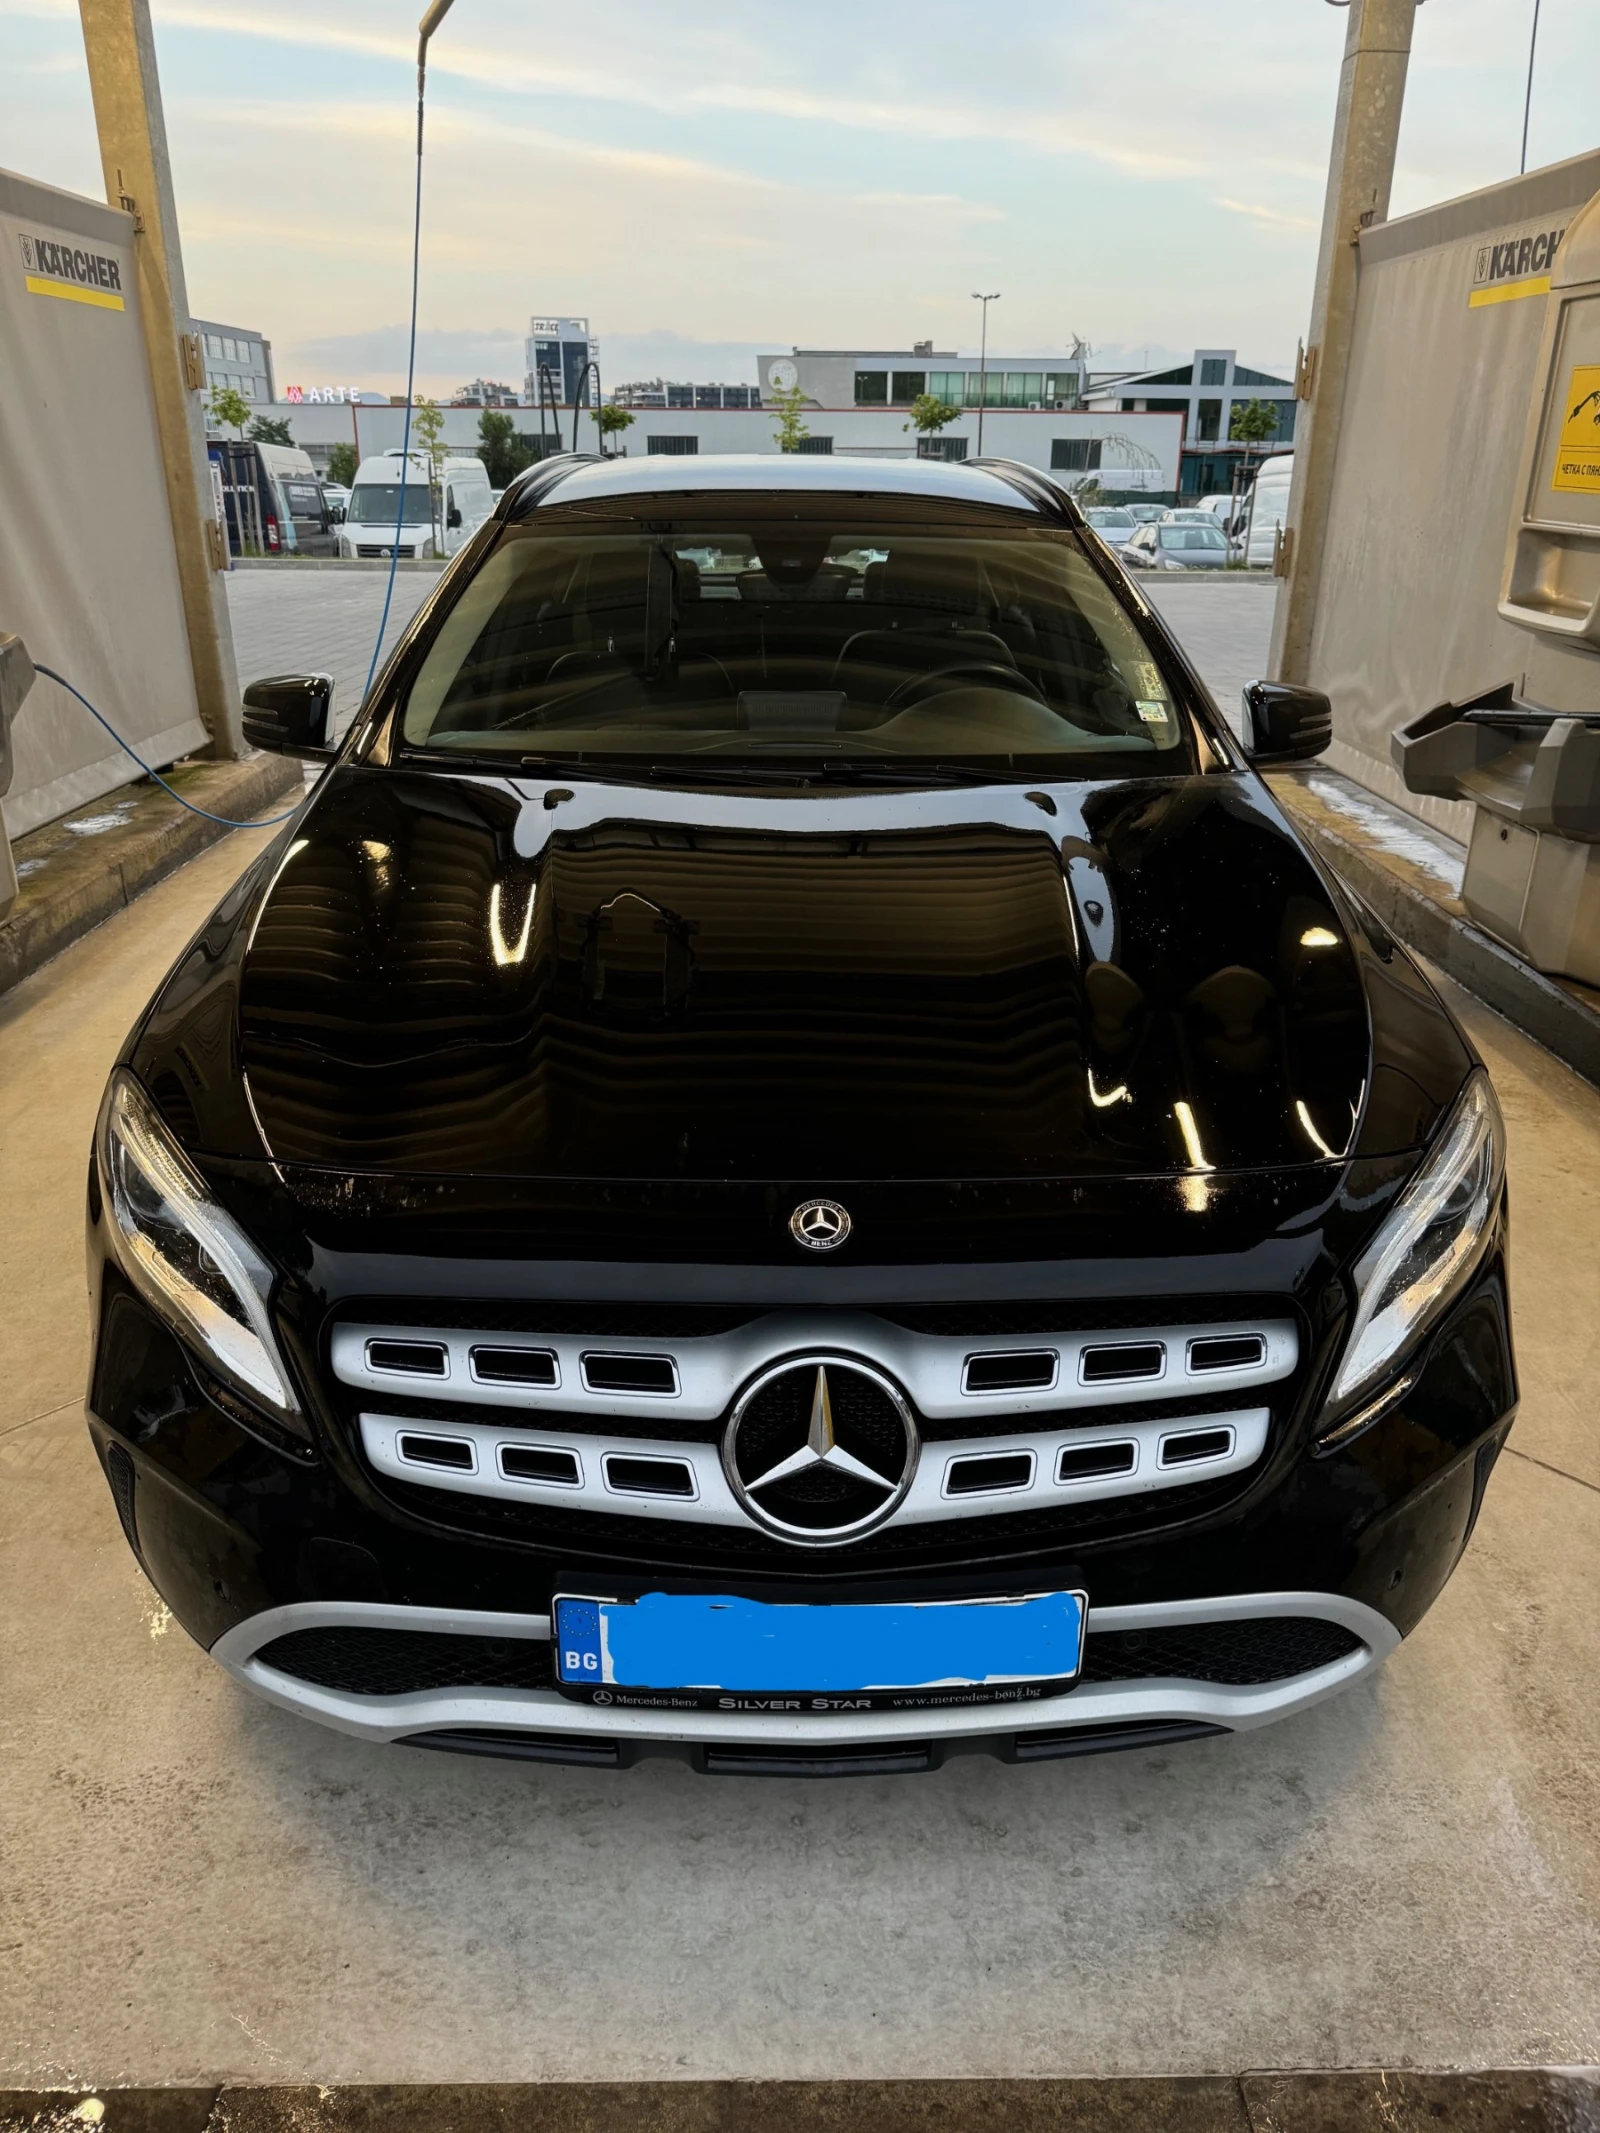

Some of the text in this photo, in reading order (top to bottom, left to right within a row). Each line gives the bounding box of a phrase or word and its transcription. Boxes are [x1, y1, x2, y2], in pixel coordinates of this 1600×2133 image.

[35, 238, 121, 290] KÄRCHER
[1489, 229, 1567, 280] KÄRCH
[309, 386, 361, 402] ARTE
[1561, 463, 1580, 475] ЧЕТКА
[565, 1651, 598, 1670] BG
[616, 1695, 698, 1707] Mercedes-Benz
[893, 1686, 1041, 1706] www.mercedes-benz.bg
